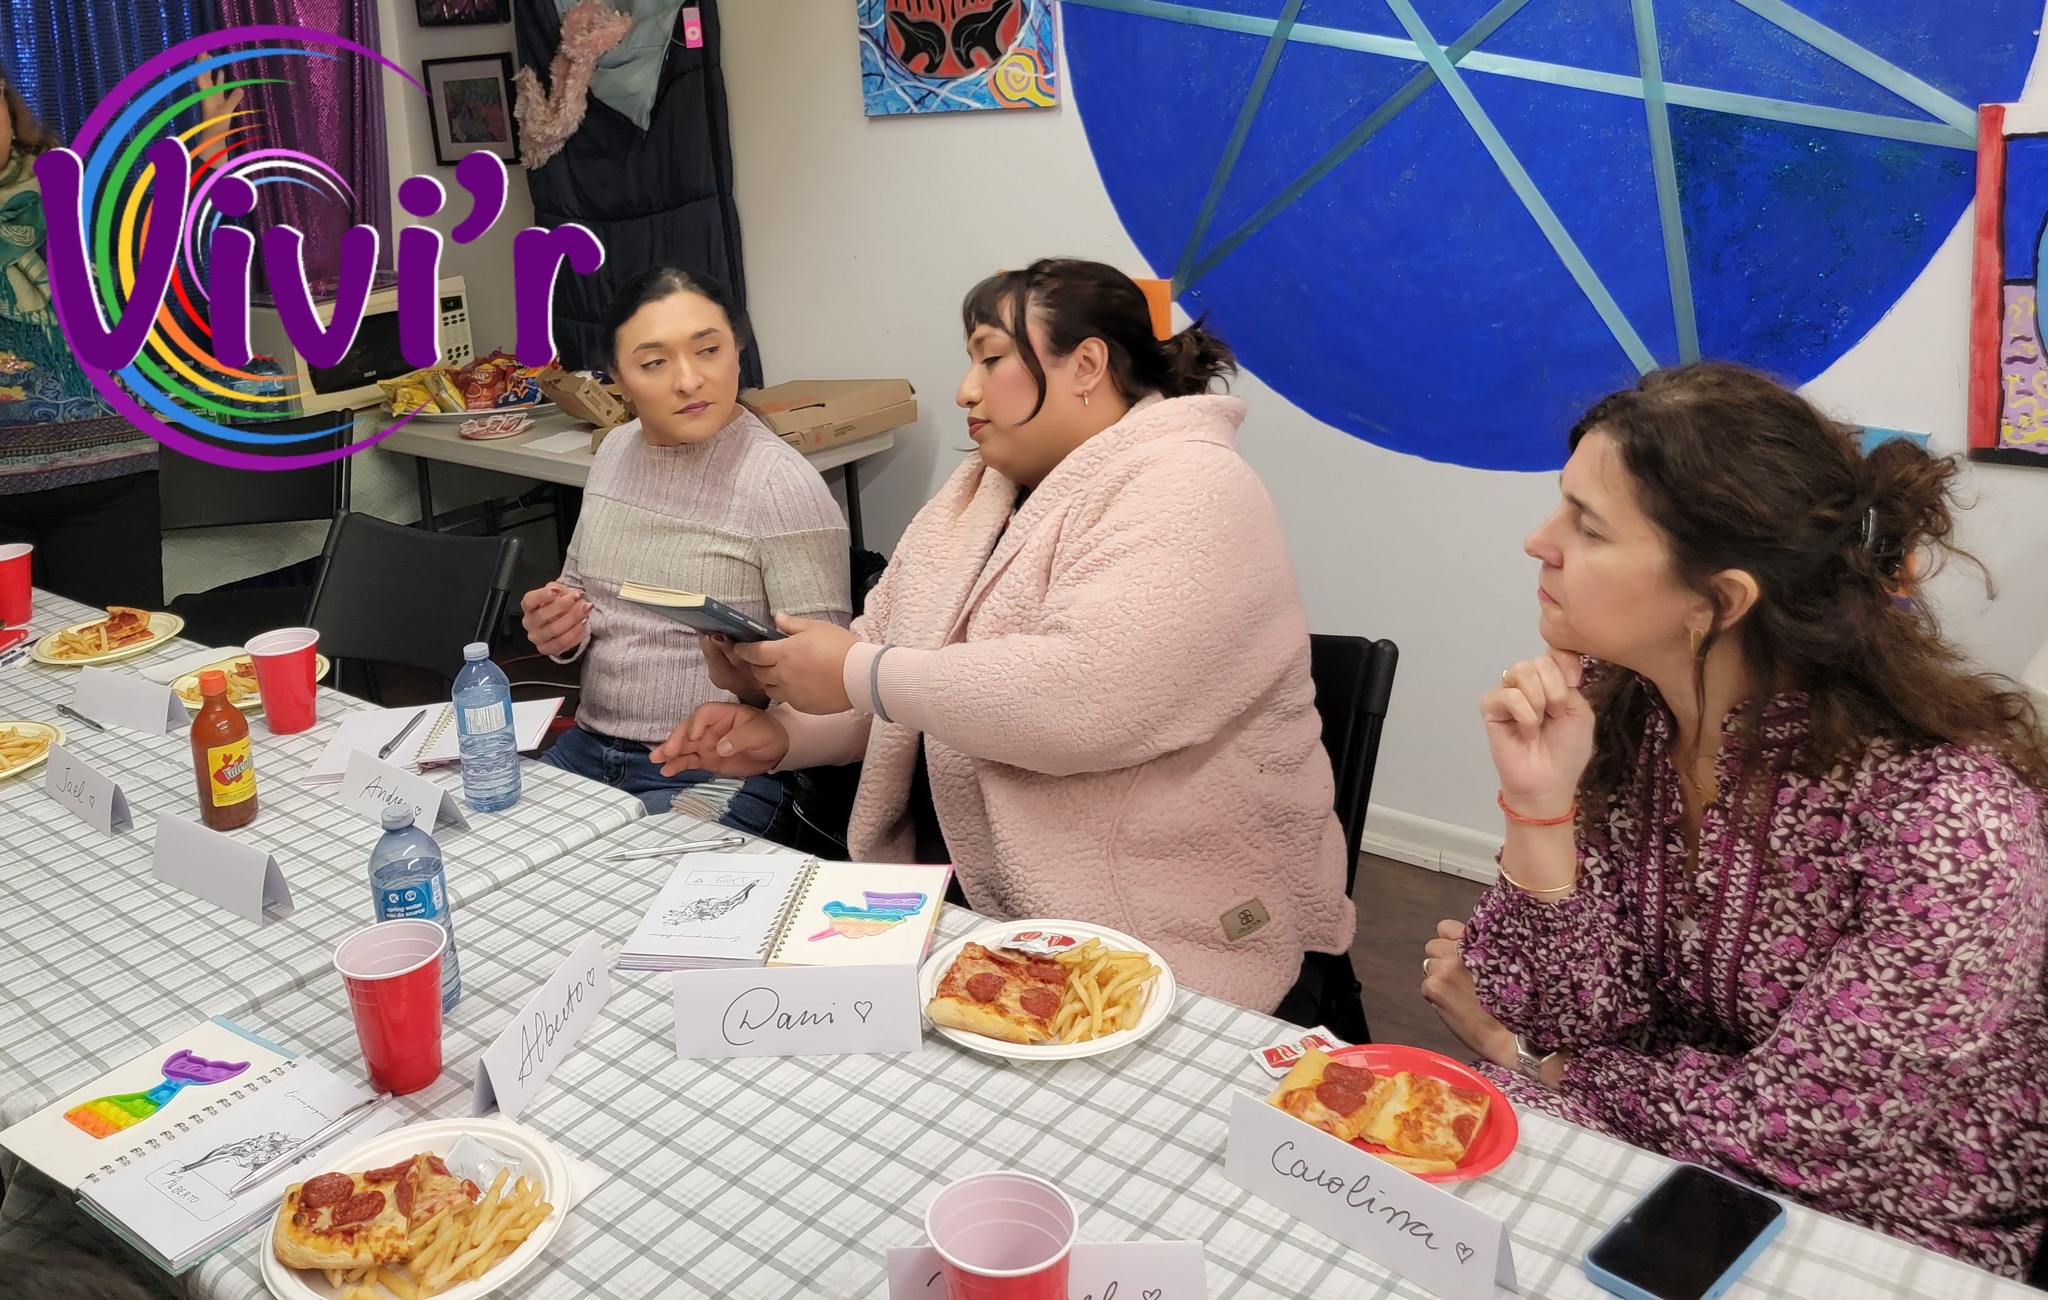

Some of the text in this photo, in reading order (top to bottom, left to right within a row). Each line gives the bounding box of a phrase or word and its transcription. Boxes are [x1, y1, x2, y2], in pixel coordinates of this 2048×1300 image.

[56, 767, 86, 804] Jael
[359, 776, 407, 806] Andre
[405, 903, 422, 911] water
[406, 908, 425, 917] source
[722, 986, 836, 1046] Dani
[518, 981, 584, 1090] Alberto
[1271, 1141, 1440, 1250] Carolina
